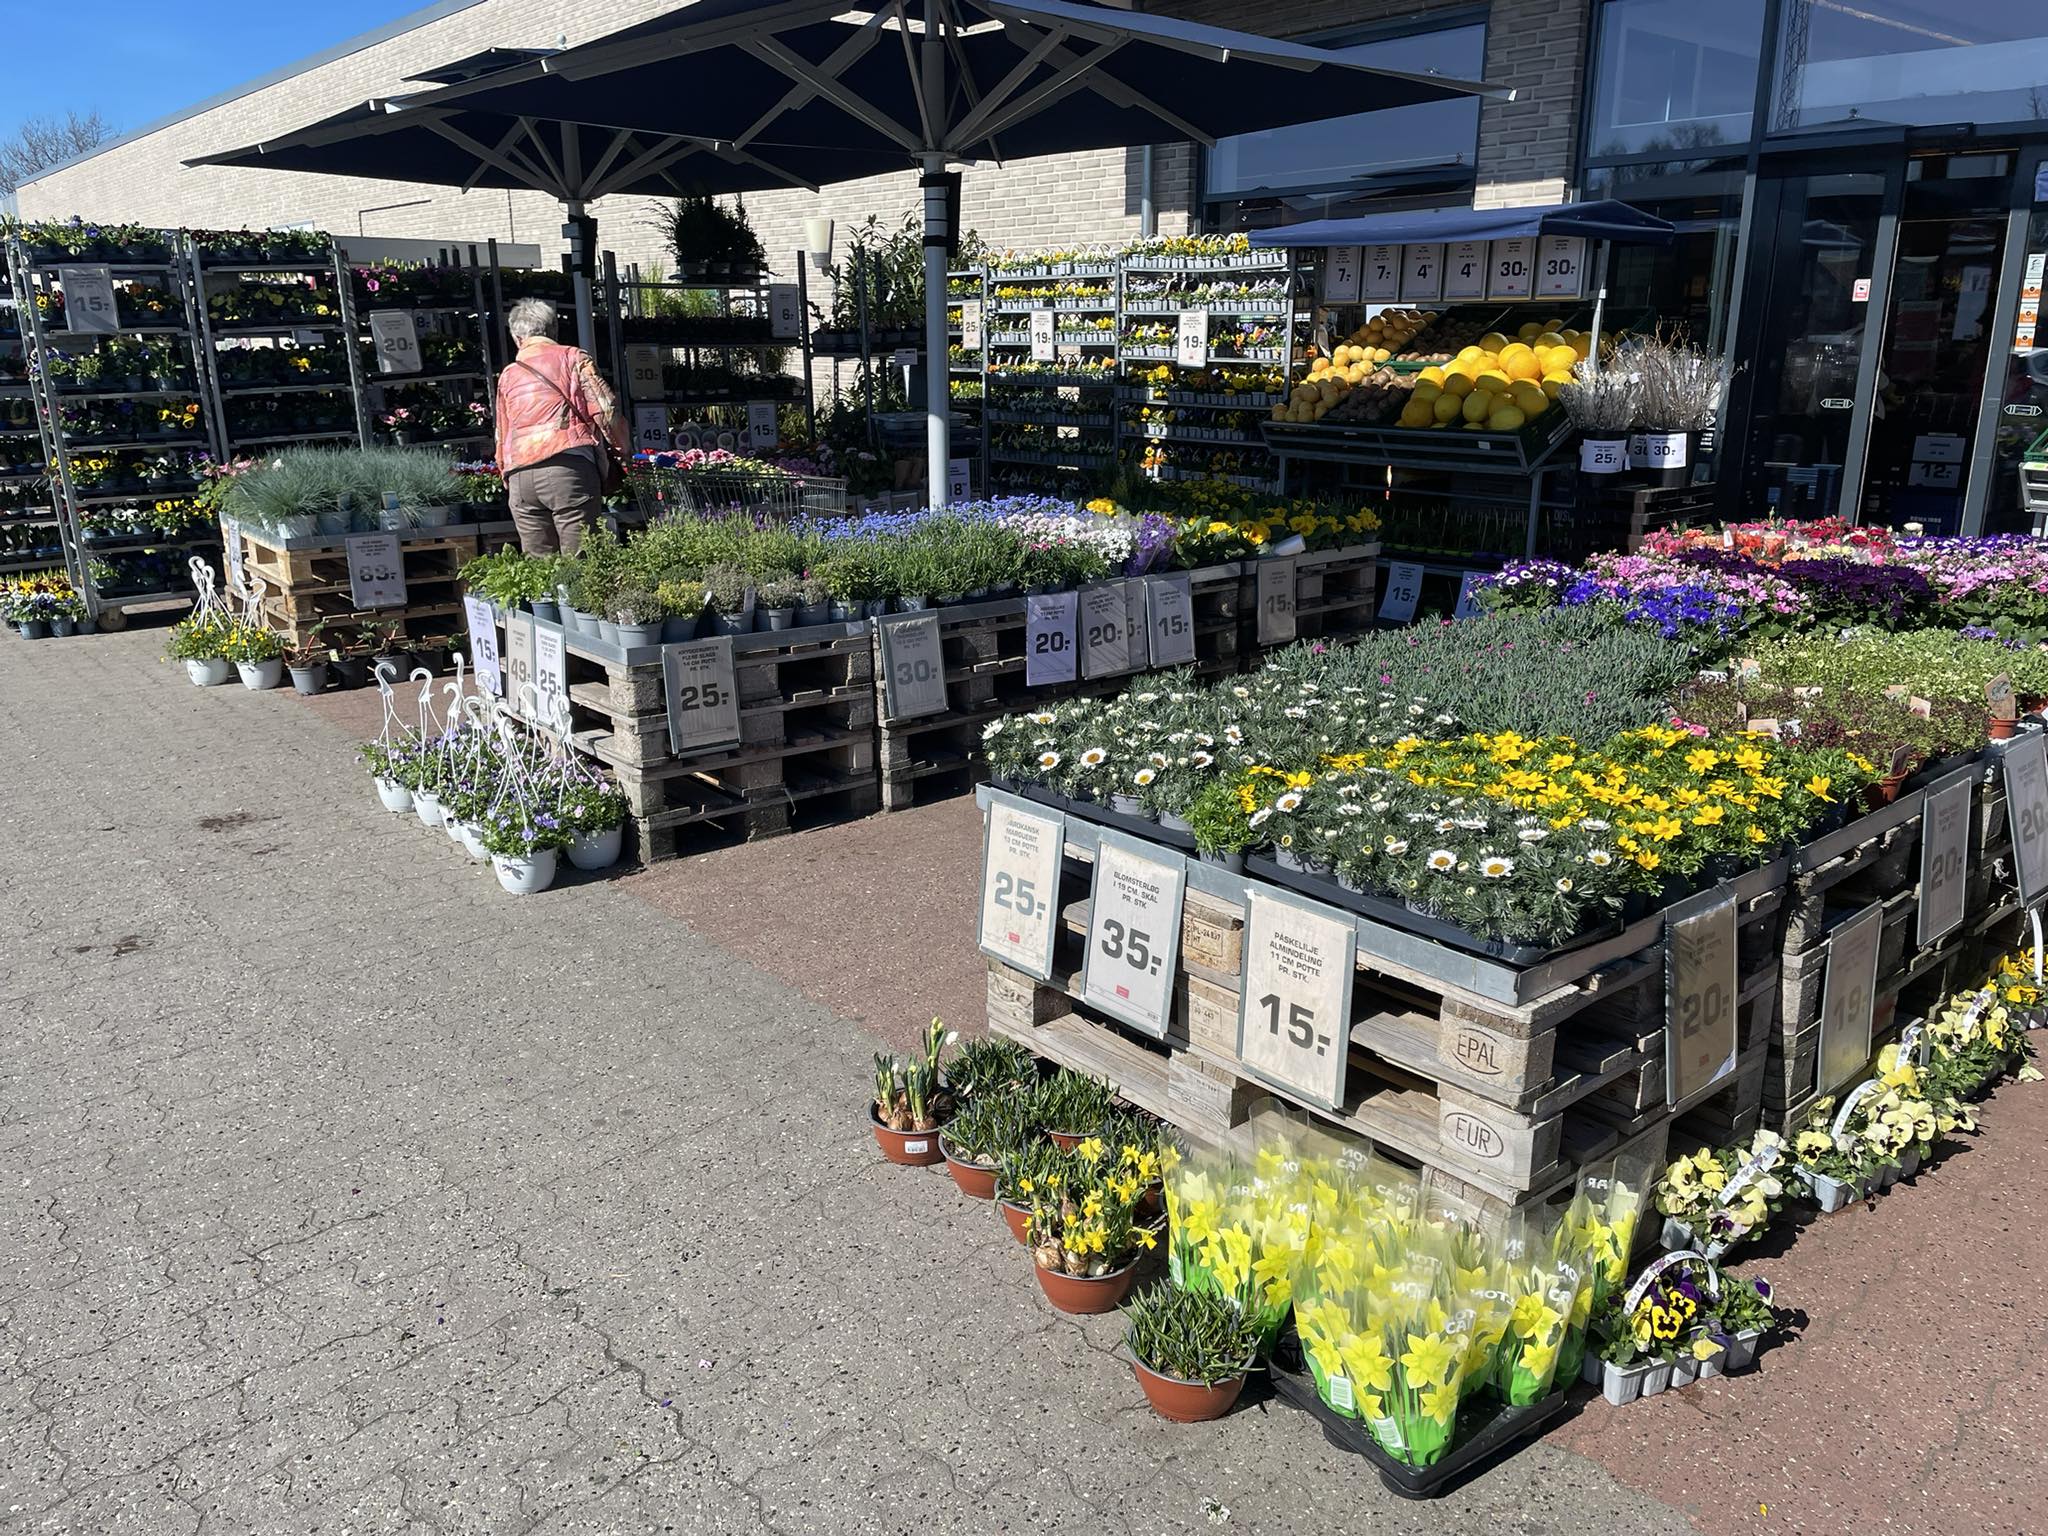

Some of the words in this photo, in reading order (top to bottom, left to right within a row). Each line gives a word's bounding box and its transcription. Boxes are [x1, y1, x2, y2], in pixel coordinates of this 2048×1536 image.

[1005, 827, 1038, 843] MARGUERIT
[1011, 838, 1022, 848] CM
[1022, 841, 1039, 853] POTTE
[1269, 940, 1323, 967] ALMINDELING
[1274, 931, 1319, 956] PÅSKELILJE
[1270, 951, 1280, 961] 11
[1281, 955, 1294, 967] CM
[1296, 961, 1321, 977] POTTE
[1457, 1034, 1499, 1070] EPAL
[1455, 1117, 1491, 1153] EUR
